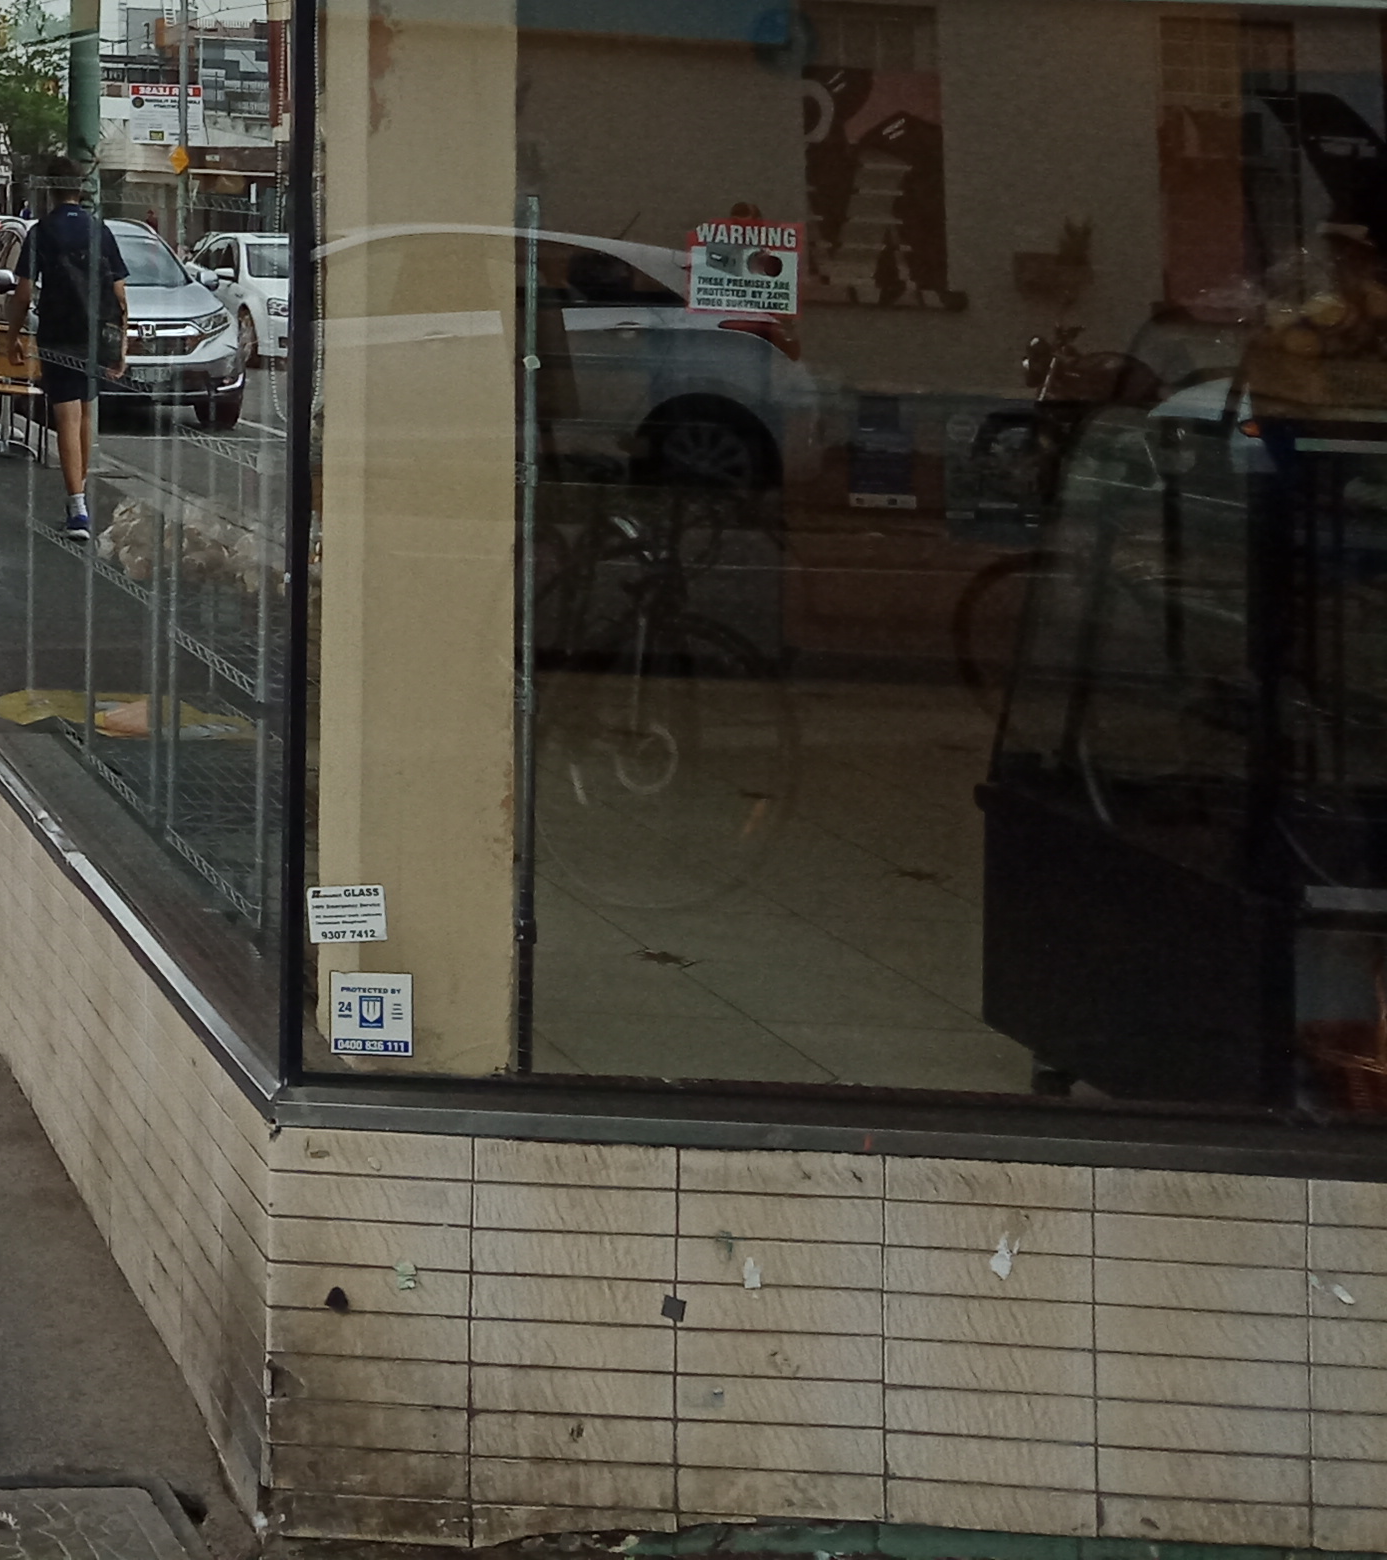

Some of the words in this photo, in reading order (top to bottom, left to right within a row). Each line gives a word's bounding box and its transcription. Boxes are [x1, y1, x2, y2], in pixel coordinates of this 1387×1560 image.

[696, 223, 797, 248] WARNING
[726, 277, 771, 289] PREMISES
[772, 280, 790, 290] ARE
[696, 287, 747, 298] PROTECTED
[750, 290, 763, 299] BY
[343, 887, 380, 897] GLASS
[349, 929, 376, 939] 7412
[340, 986, 389, 994] PROTECTED
[337, 1001, 352, 1013] 24
[337, 1039, 363, 1050] 0400
[386, 1041, 405, 1052] 111
